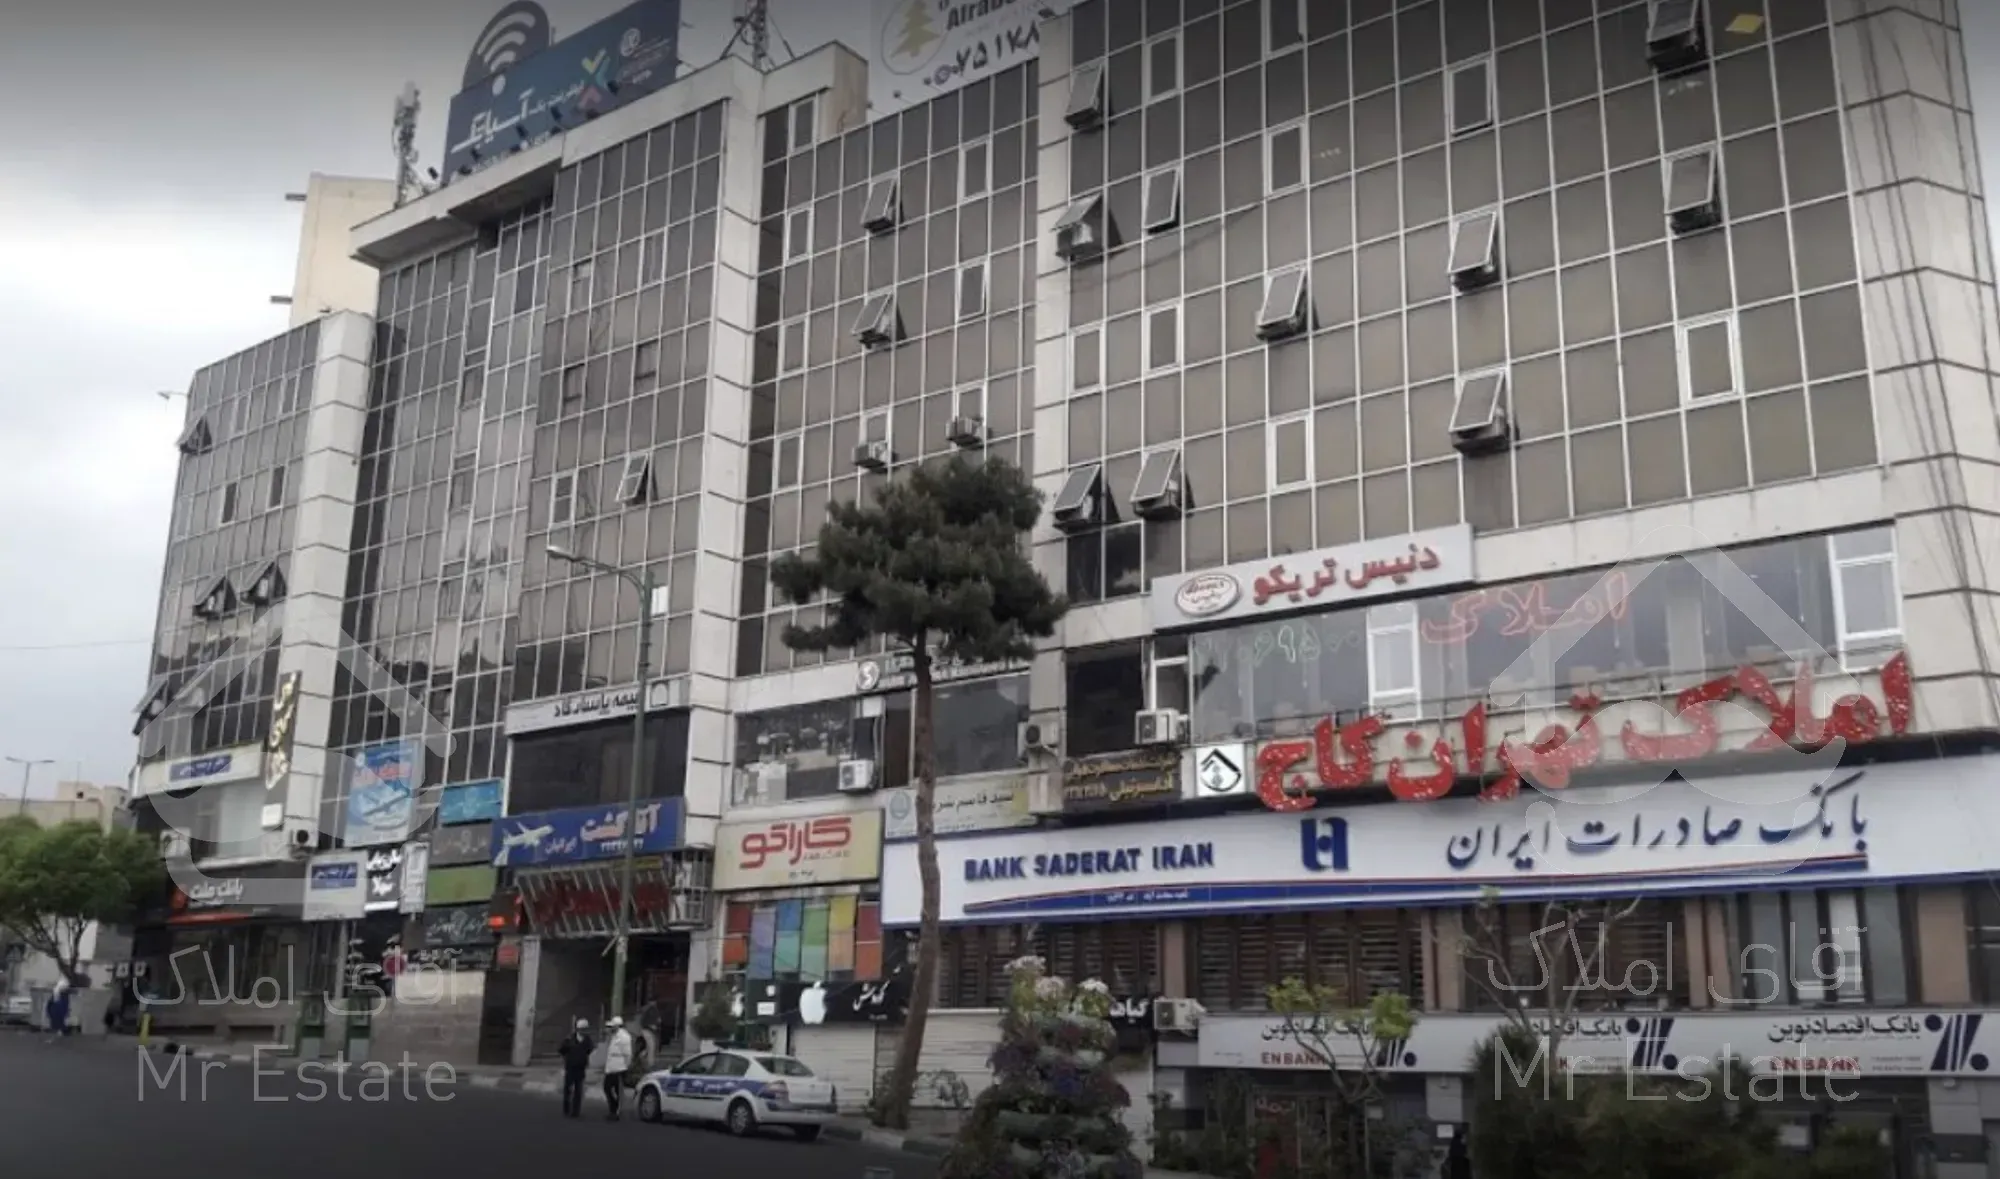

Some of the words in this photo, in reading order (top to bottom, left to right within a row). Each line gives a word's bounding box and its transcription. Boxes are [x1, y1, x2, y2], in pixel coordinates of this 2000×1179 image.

[1253, 557, 1338, 606] تریکو
[1346, 543, 1440, 589] دنیس
[1621, 650, 1912, 761] املاک
[1256, 711, 1391, 813] کاج
[1387, 690, 1602, 802] تهران
[1565, 806, 1744, 854] صادرات
[1760, 770, 1868, 852] بانک
[739, 816, 852, 870] کاراتو
[964, 856, 1026, 882] BANK
[1034, 847, 1142, 876] SADERAT
[1153, 841, 1215, 870] IRAN
[1446, 820, 1551, 869] ایران
[1768, 1018, 1812, 1042] نوین
[1811, 1015, 1869, 1035] اقتصاد
[1871, 1014, 1921, 1039] بانک
